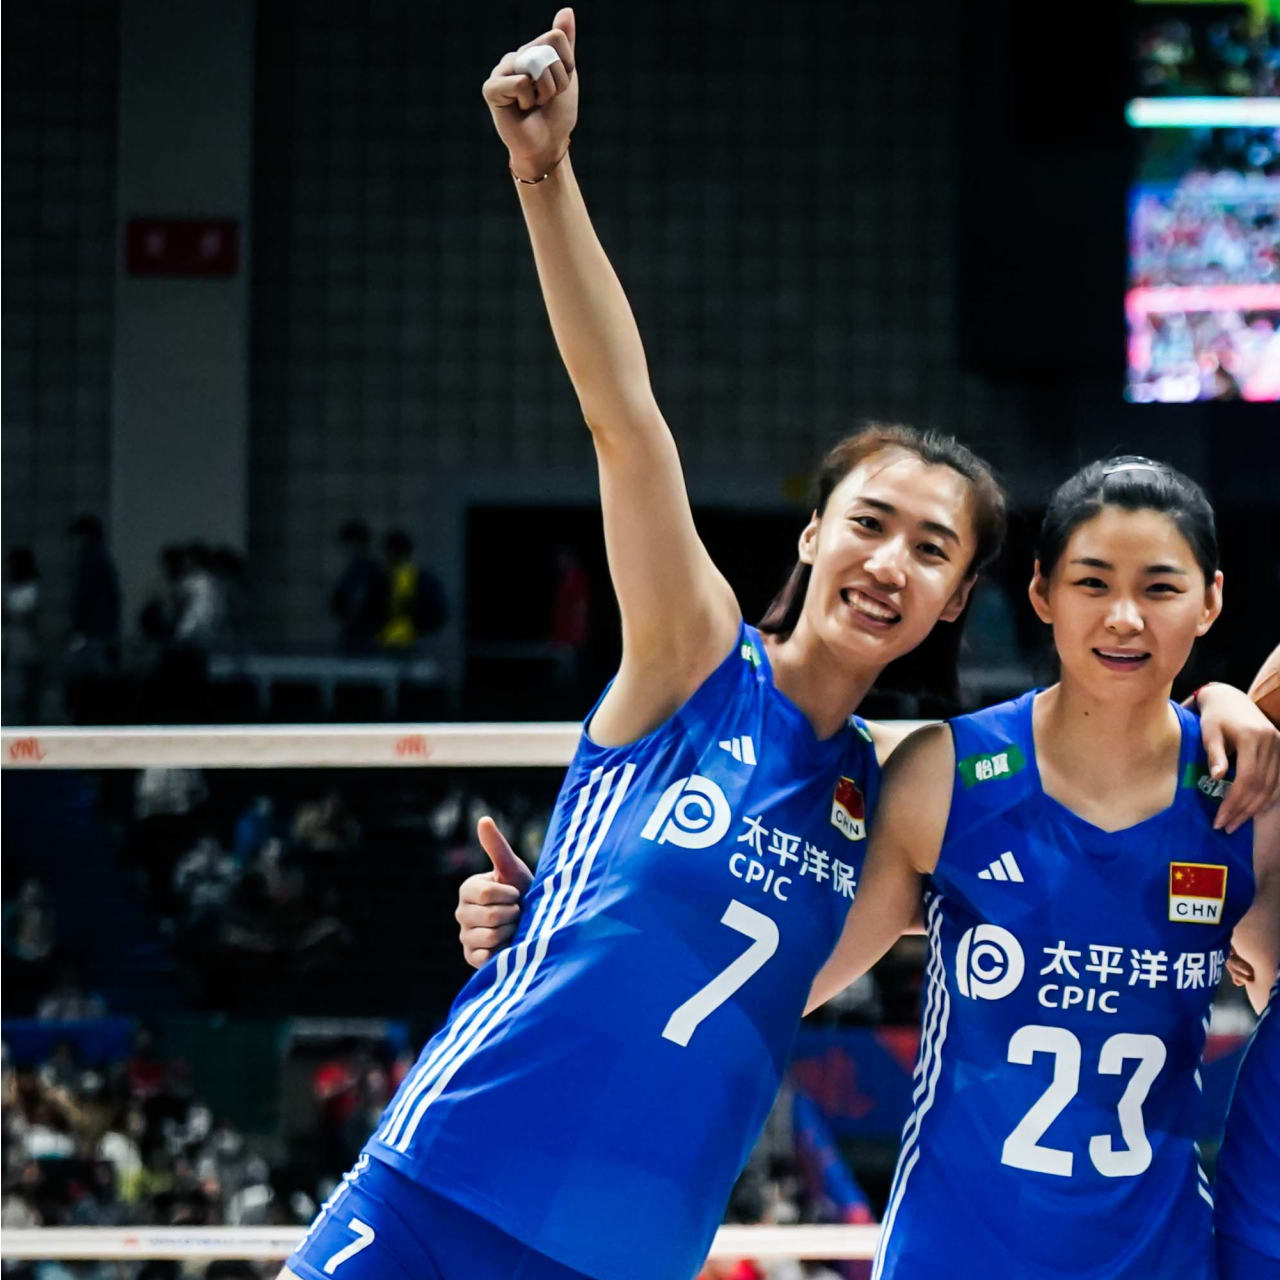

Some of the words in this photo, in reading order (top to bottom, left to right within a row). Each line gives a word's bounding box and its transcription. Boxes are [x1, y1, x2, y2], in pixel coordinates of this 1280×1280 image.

[836, 809, 859, 836] CHN
[728, 851, 793, 902] CPIC
[1176, 902, 1217, 918] CHN
[661, 898, 780, 1047] 7
[1038, 984, 1120, 1014] CPIC
[1001, 1024, 1168, 1177] 23
[323, 1217, 376, 1275] 7
